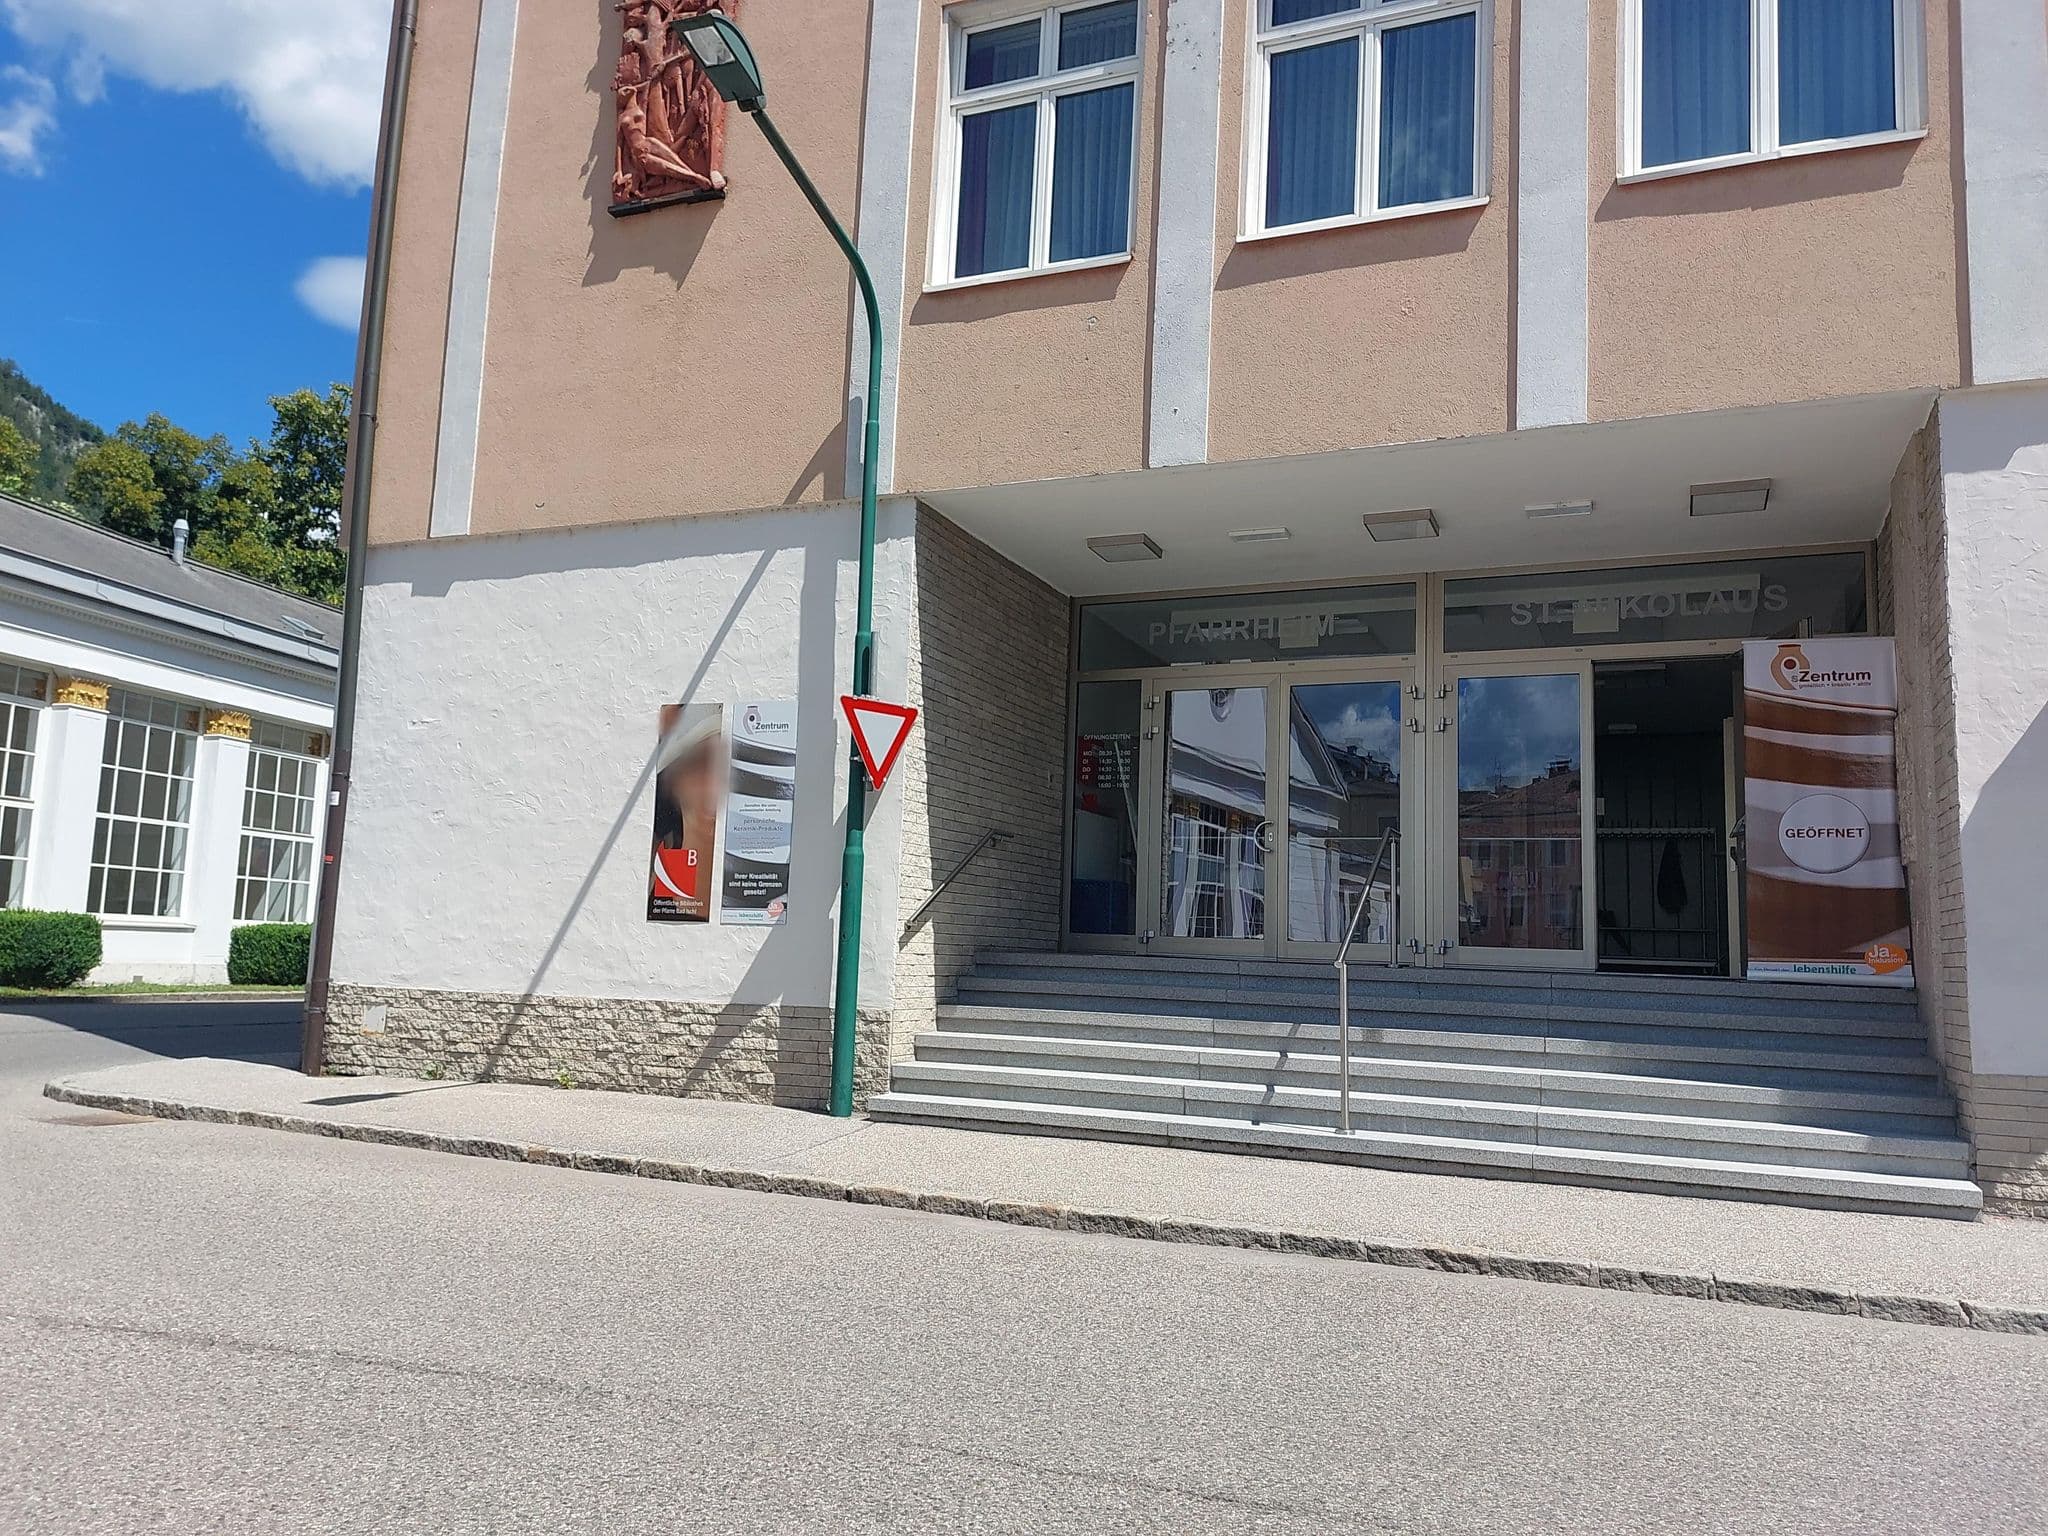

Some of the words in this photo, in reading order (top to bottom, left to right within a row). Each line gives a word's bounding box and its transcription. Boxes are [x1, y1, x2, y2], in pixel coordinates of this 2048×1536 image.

[1577, 584, 1788, 622] KOLAUS
[1150, 613, 1335, 645] PFARRHM
[1785, 826, 1865, 838] GEÖFFNET
[687, 849, 698, 866] B
[1868, 945, 1889, 958] Ja
[1793, 964, 1857, 975] lebenshilfe
